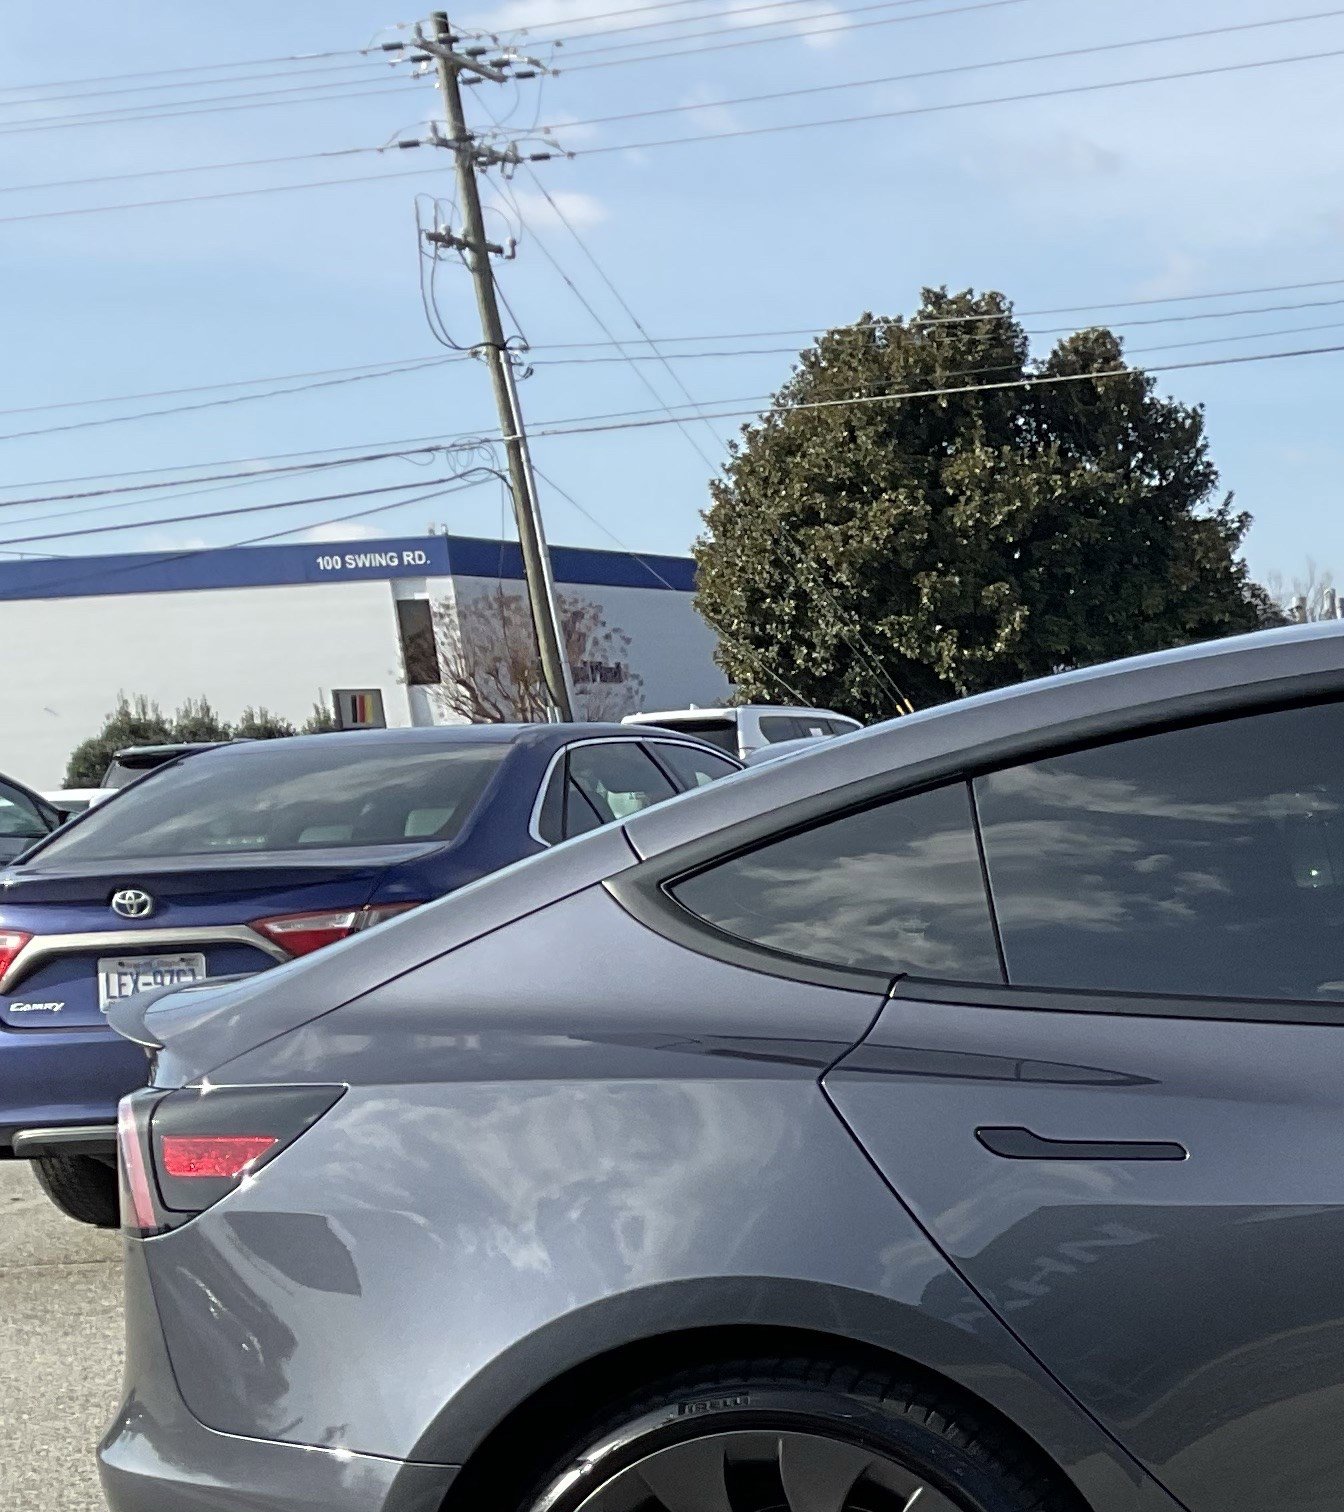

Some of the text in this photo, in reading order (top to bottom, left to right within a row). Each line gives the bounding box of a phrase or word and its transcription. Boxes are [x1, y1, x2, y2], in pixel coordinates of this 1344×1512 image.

[316, 550, 431, 570] 100 SWING RD.
